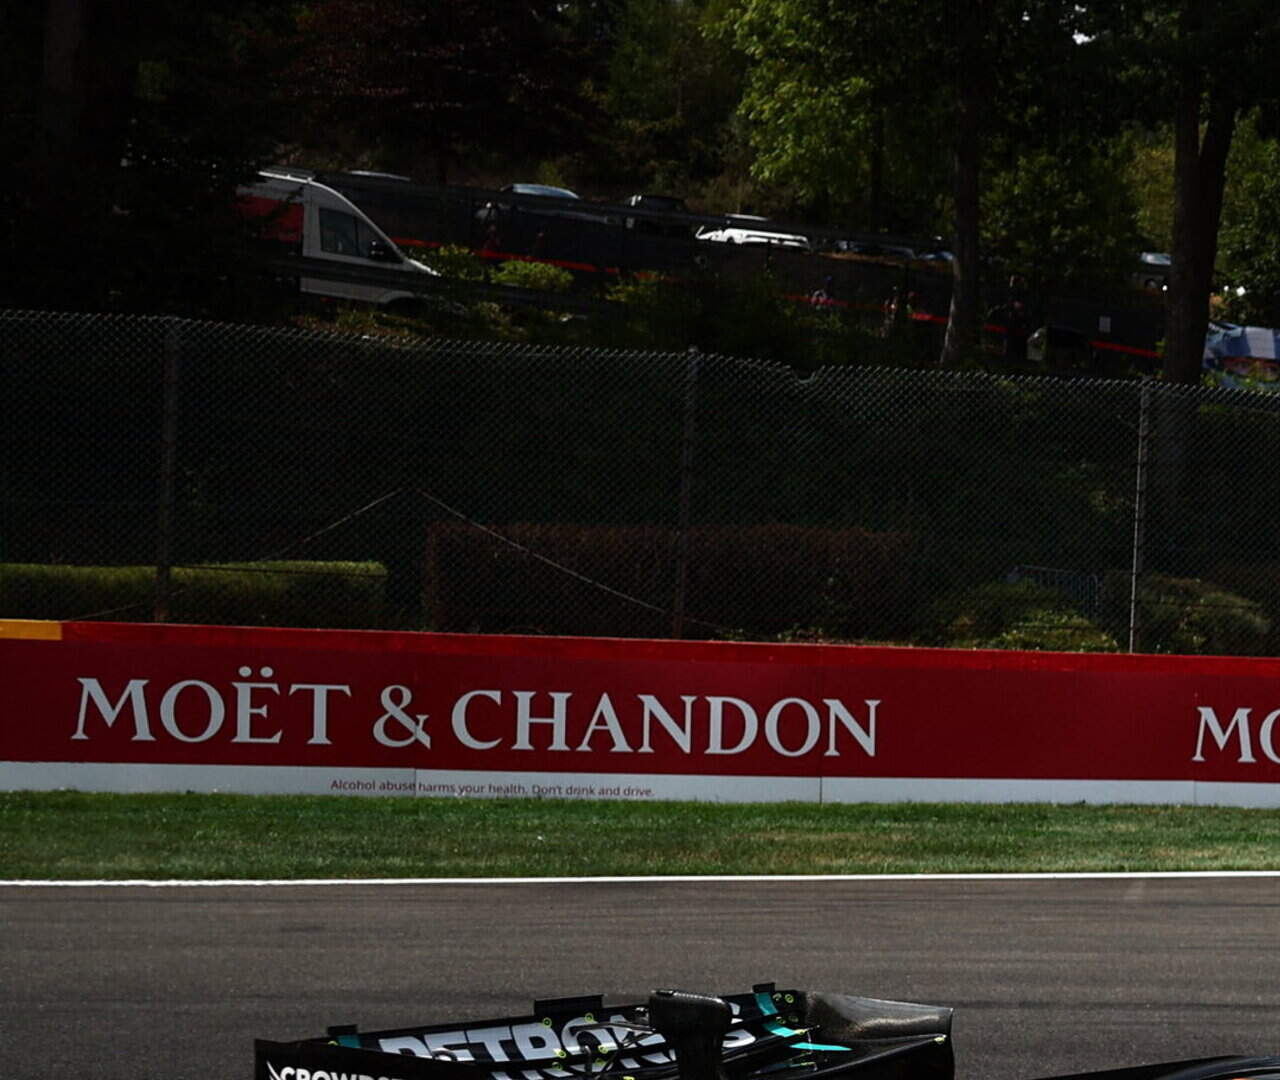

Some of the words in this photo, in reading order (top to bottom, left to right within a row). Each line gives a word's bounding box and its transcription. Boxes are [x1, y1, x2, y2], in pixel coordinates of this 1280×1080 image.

[71, 666, 351, 745] MOËT
[373, 684, 431, 749] &
[451, 688, 881, 758] CHANDON
[331, 779, 375, 791] Alcohol
[378, 780, 415, 792] abuse
[418, 782, 456, 793] harms
[458, 784, 486, 796] your
[489, 782, 526, 794] health.
[598, 785, 620, 796] and
